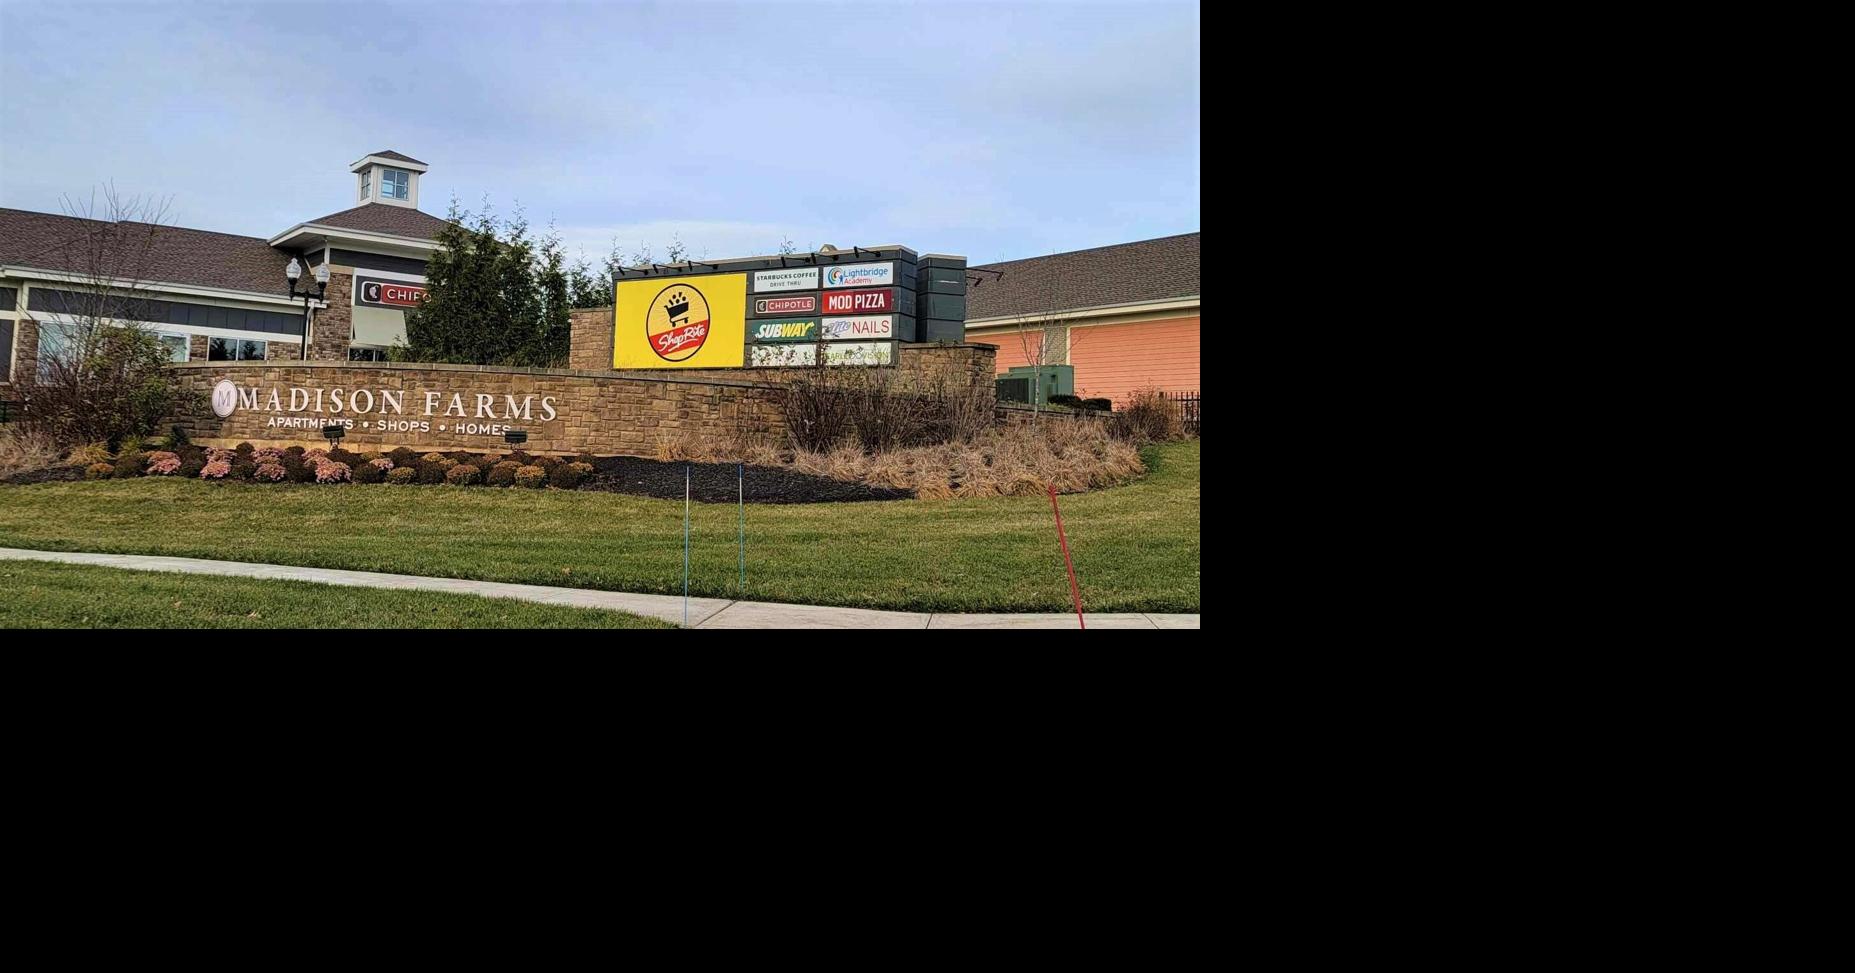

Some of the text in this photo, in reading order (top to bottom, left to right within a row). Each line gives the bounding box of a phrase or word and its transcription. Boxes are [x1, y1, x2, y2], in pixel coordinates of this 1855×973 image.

[843, 267, 889, 279] Lightbridge
[843, 278, 873, 286] Academy
[768, 300, 812, 310] CHIPOTLE
[828, 293, 885, 310] MOD PIZZA
[755, 321, 815, 339] SUBWAY
[852, 320, 890, 335] NAILS
[658, 324, 705, 352] ShopRite
[237, 387, 557, 422] MADISON FARMS
[267, 416, 512, 436] APARTMENTS SHOPS HOMES
